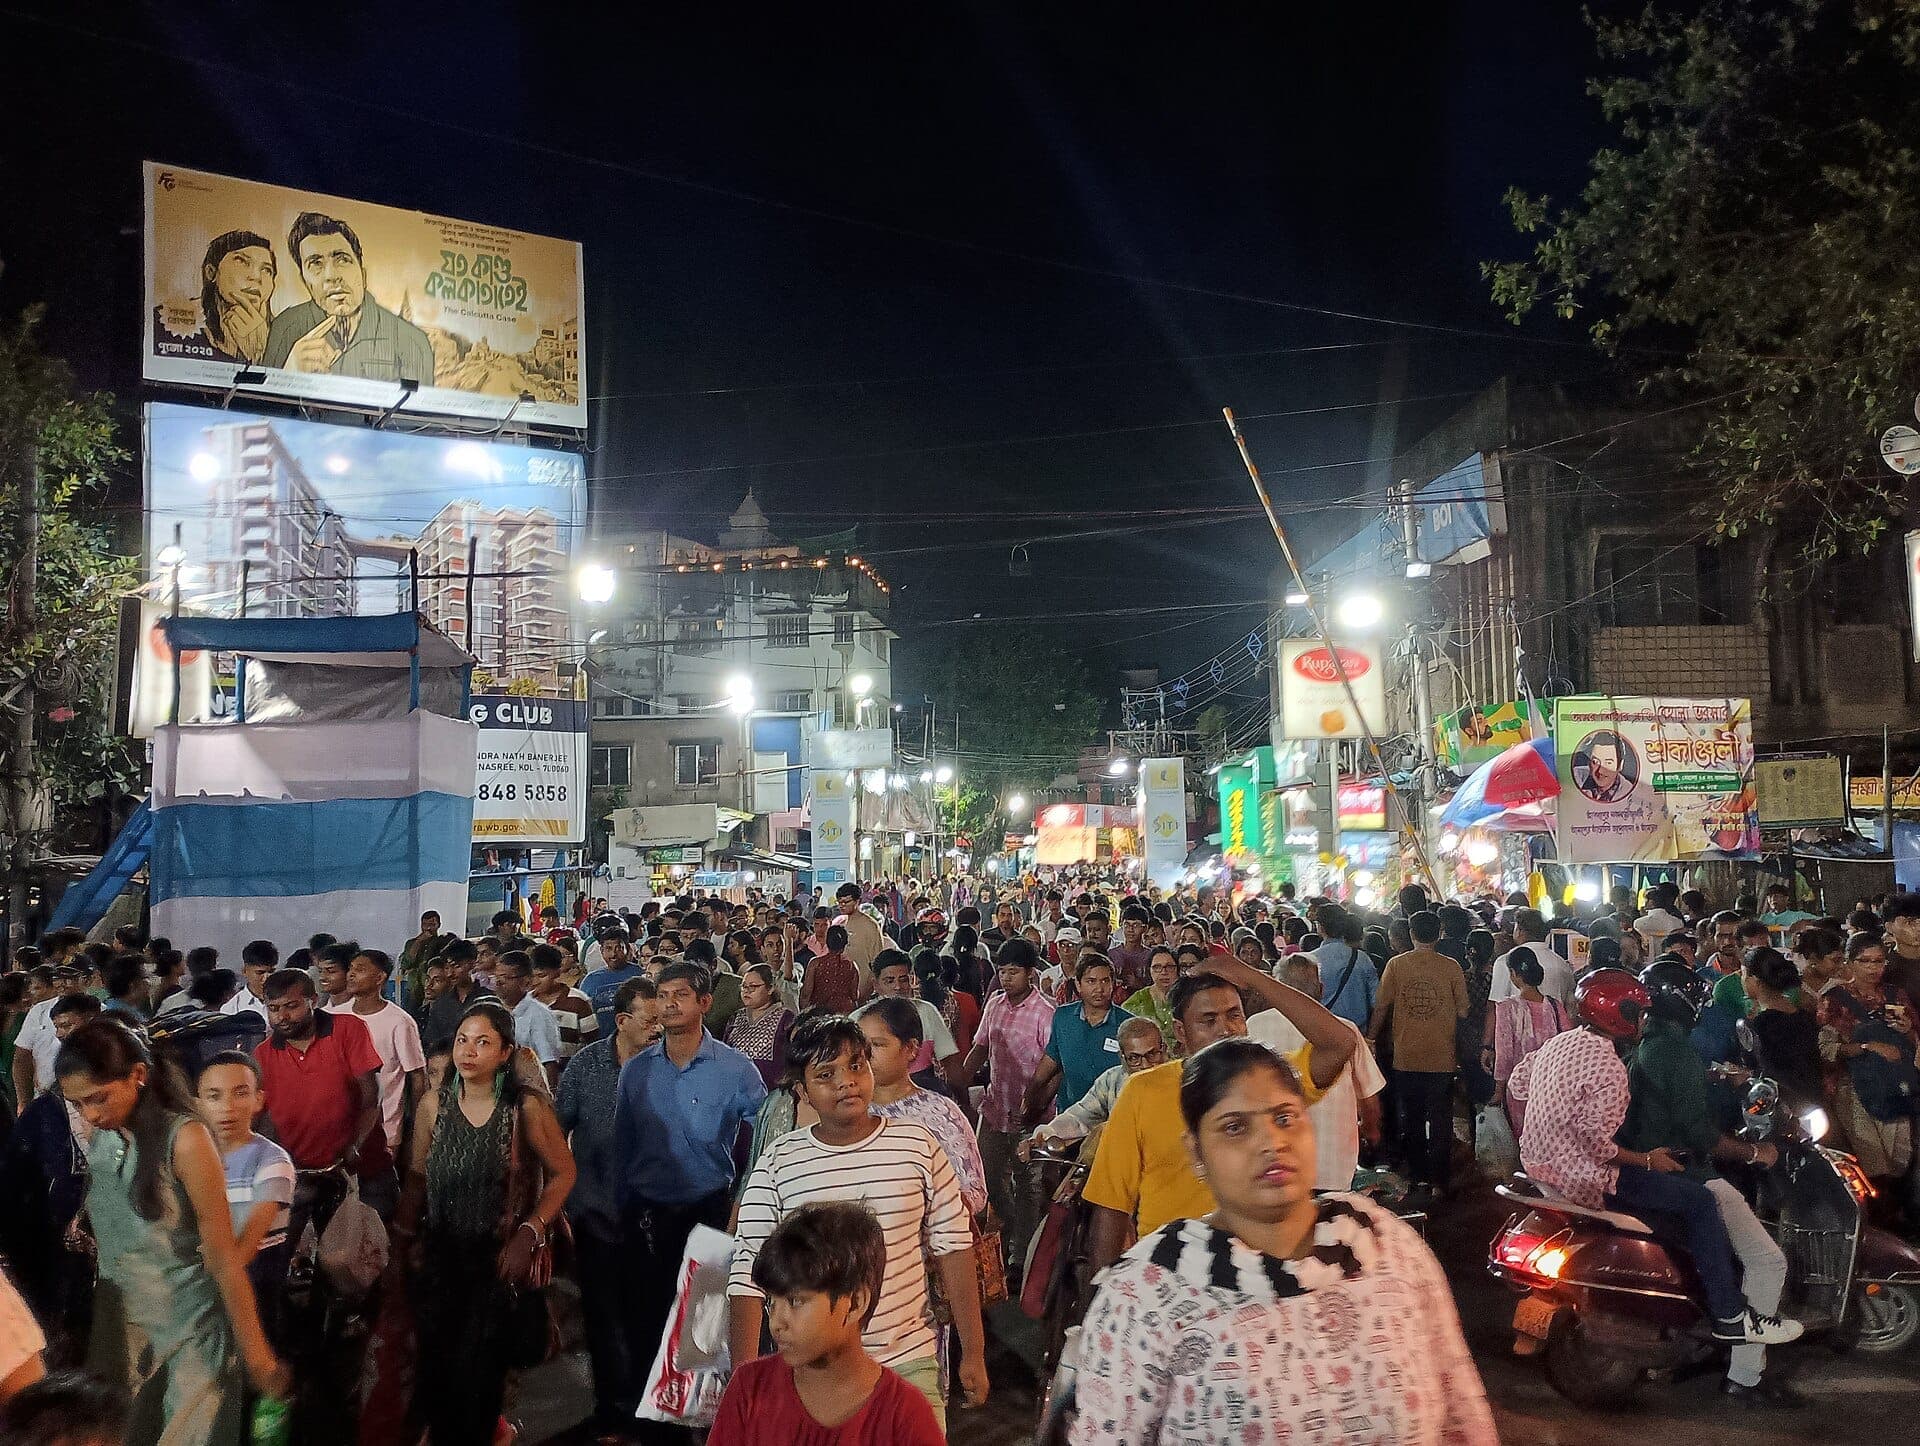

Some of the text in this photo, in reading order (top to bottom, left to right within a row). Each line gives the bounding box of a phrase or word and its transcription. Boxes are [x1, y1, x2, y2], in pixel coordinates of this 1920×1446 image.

[440, 249, 512, 285] যত কাণ্ড
[424, 271, 528, 313] কলকাতাতেই
[461, 309, 494, 320] Calcutta
[496, 314, 517, 322] Case
[495, 703, 553, 725] CLUB
[502, 752, 525, 761] NATH
[527, 753, 568, 763] BANERJEE
[519, 764, 534, 772] KOL
[478, 784, 567, 801] 848 5858
